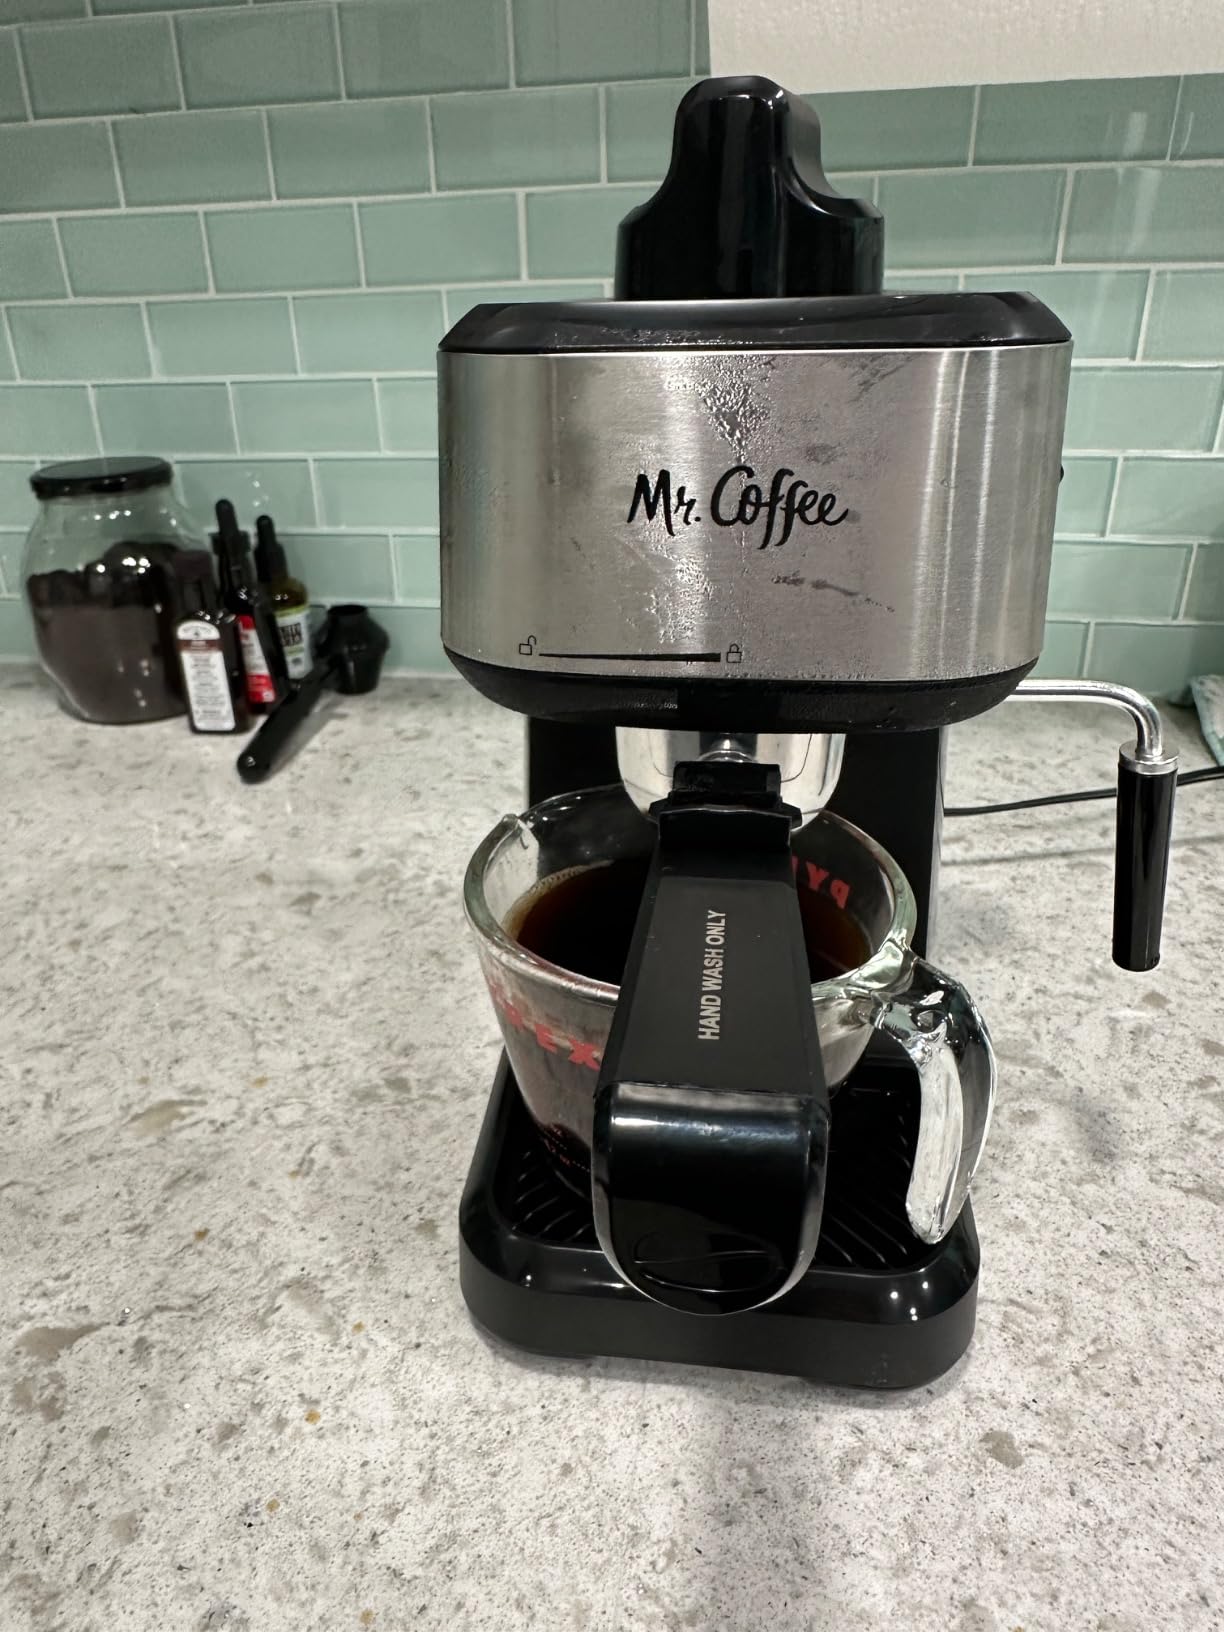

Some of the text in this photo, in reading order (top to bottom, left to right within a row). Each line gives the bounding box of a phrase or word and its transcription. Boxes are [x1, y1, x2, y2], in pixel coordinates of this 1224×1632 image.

[627, 465, 849, 550] Mr. Coffee
[697, 909, 727, 1041] HAND WASH ONLY
